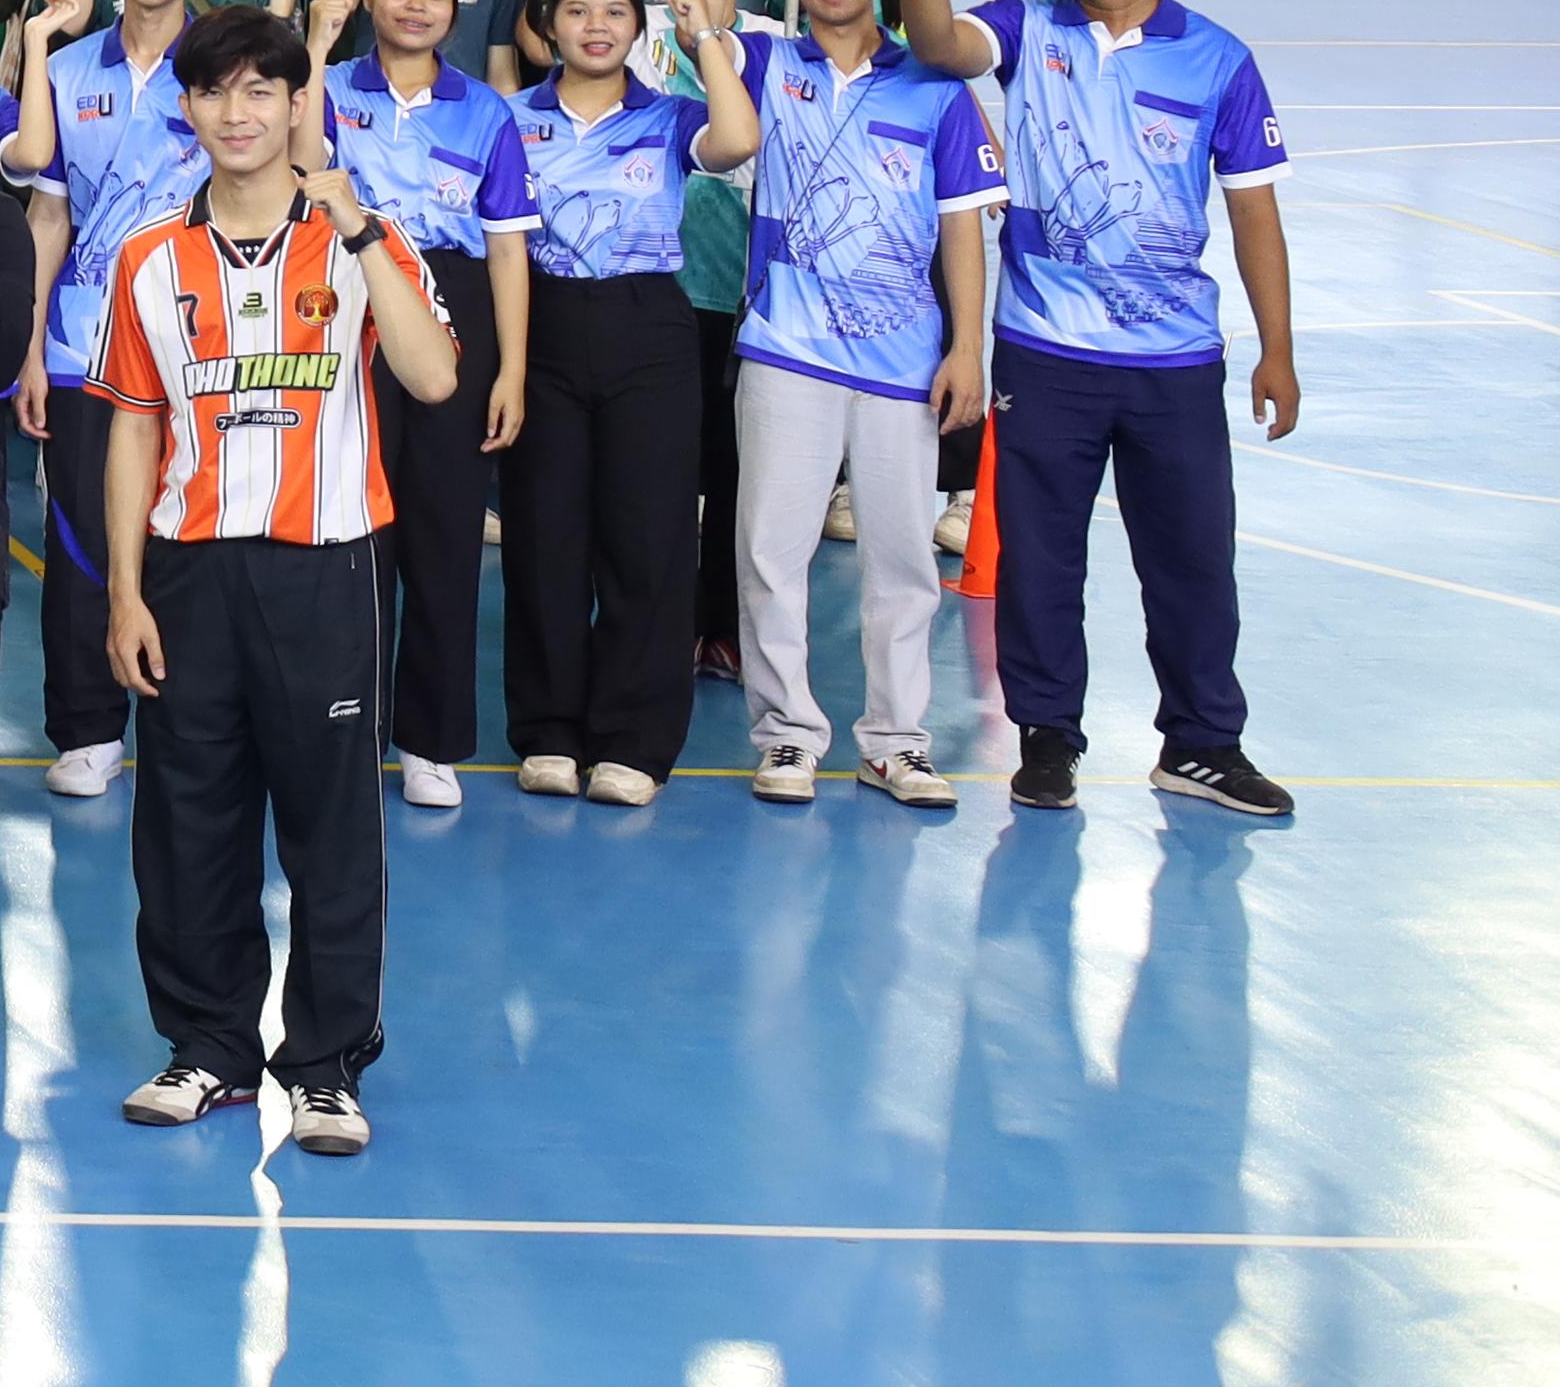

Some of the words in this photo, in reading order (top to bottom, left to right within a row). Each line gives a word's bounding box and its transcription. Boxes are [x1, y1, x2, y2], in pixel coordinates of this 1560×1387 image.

[76, 92, 113, 118] EDU
[1263, 115, 1282, 148] 6
[235, 353, 341, 392] THONG
